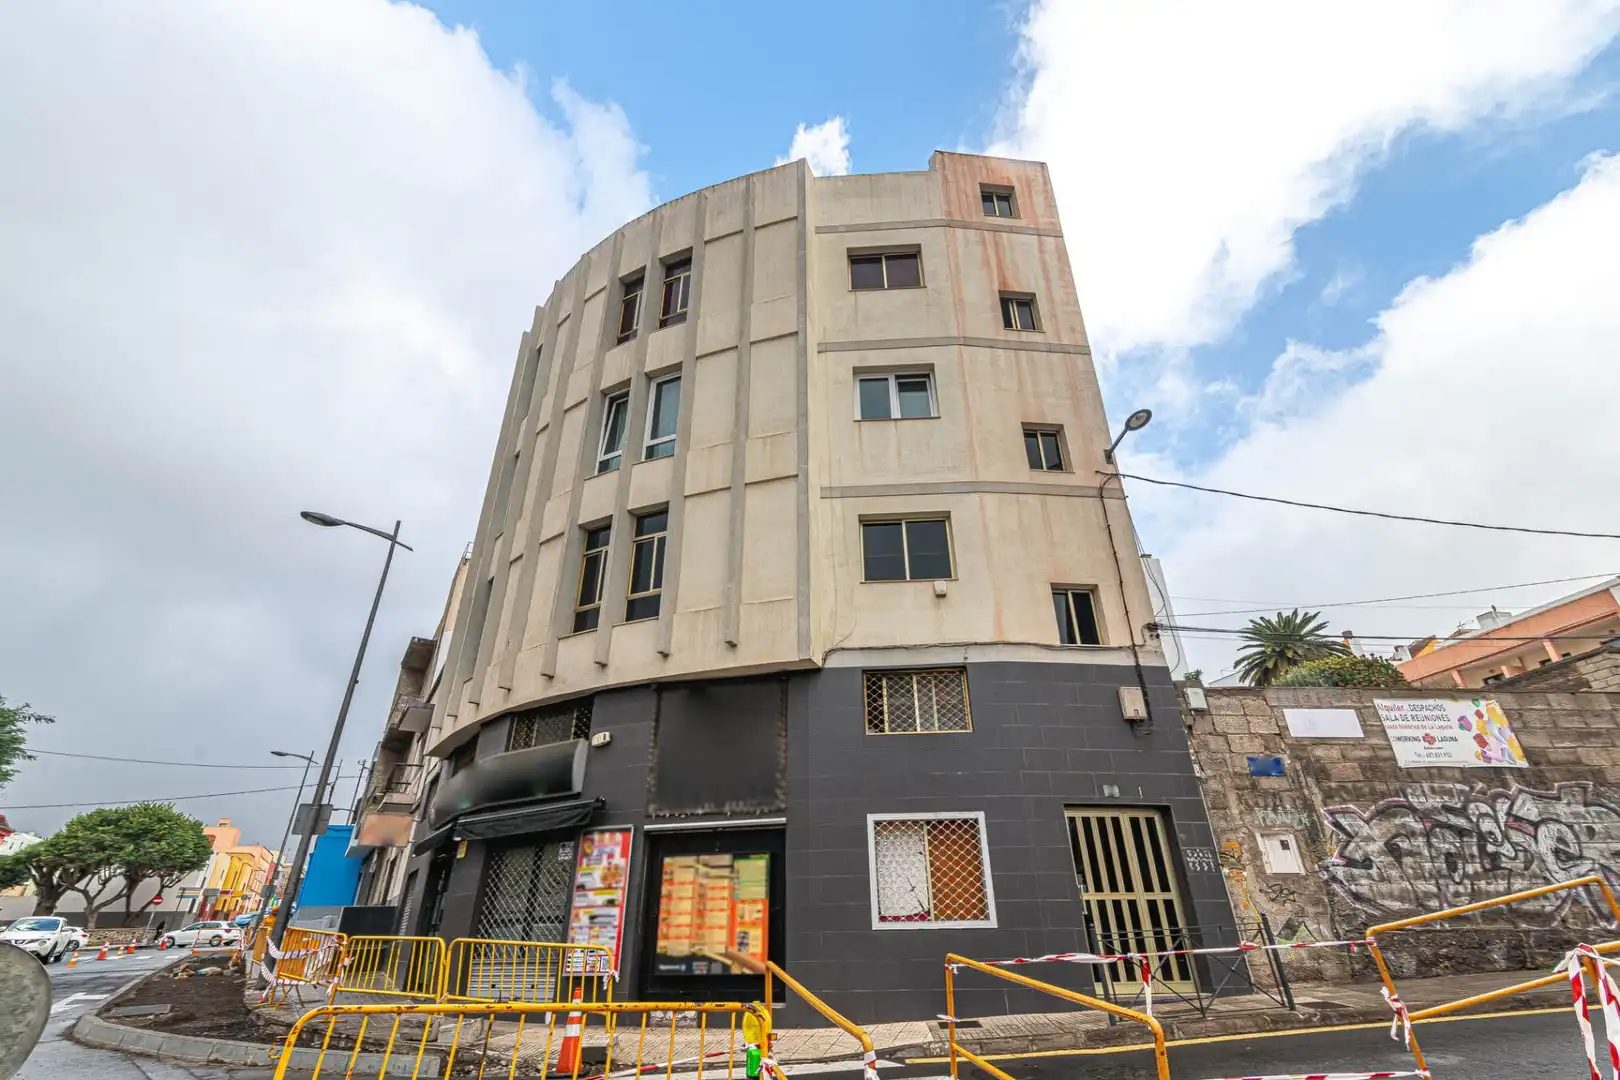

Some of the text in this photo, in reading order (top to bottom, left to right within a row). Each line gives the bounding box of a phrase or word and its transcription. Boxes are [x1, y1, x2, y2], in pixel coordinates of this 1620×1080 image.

[1408, 704, 1446, 712] DESPACHOS
[1381, 714, 1451, 722] SALA DE REUNIONES
